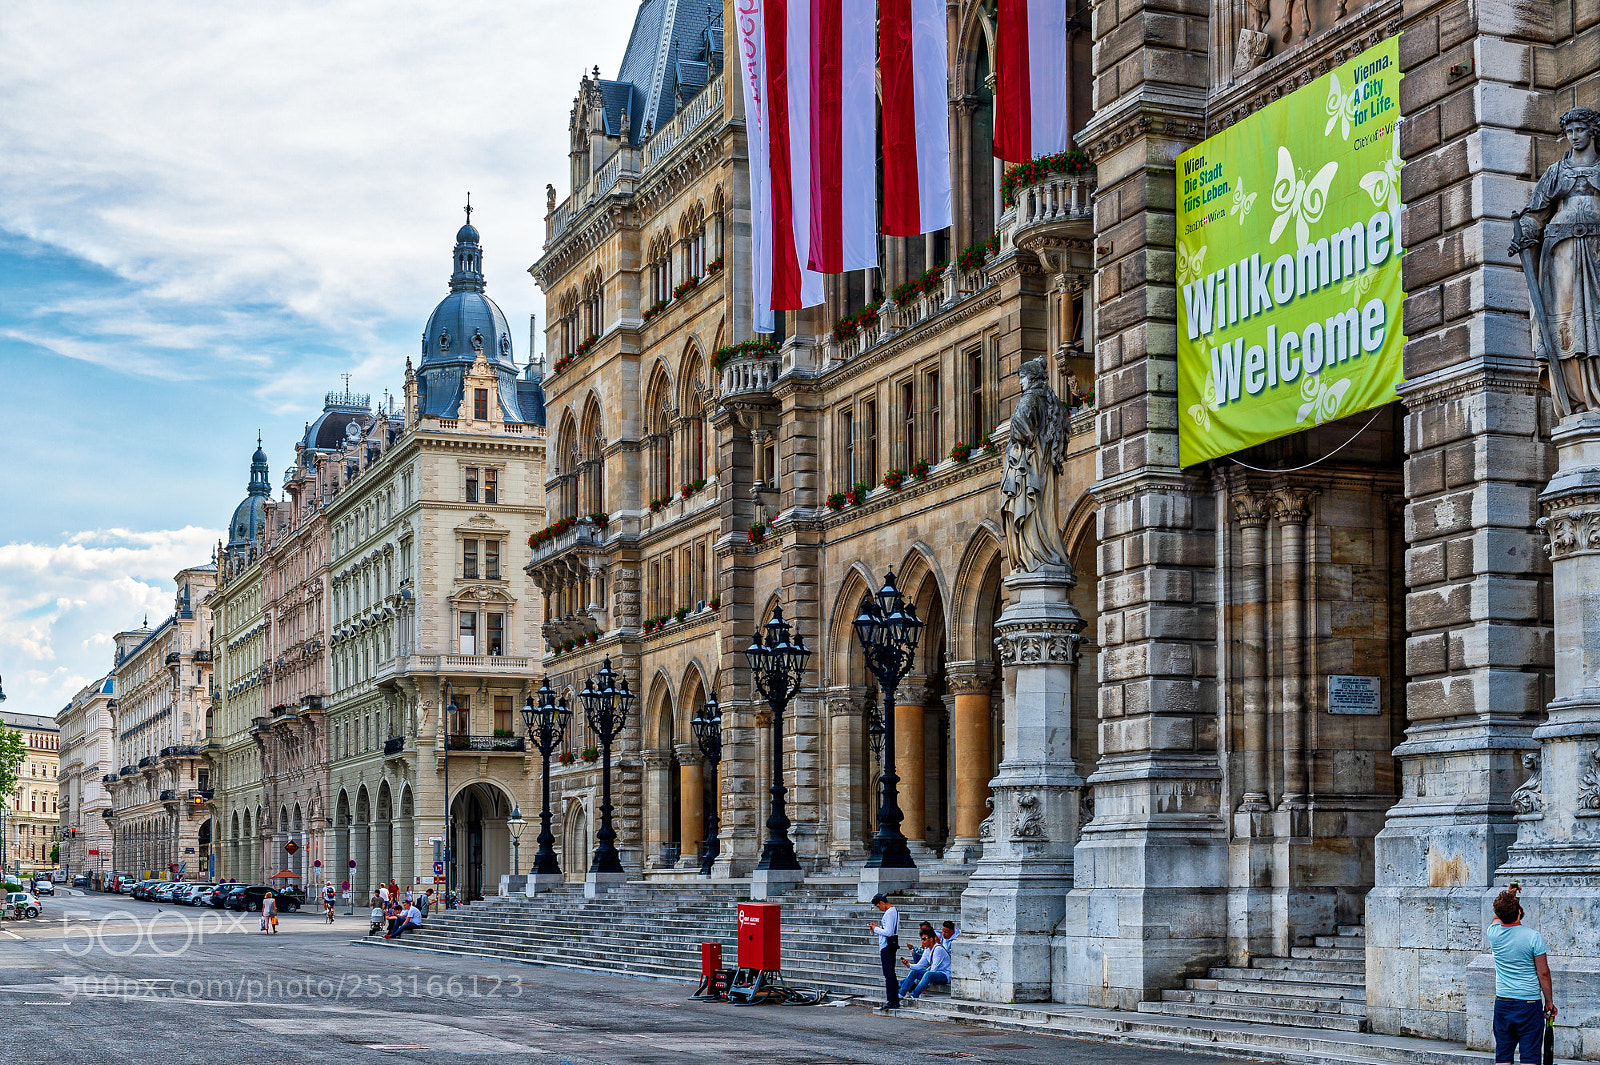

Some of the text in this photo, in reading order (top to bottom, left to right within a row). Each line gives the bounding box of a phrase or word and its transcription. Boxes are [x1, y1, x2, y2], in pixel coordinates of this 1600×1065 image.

[1354, 54, 1393, 85] Vienna.
[1353, 78, 1384, 107] A City
[1353, 95, 1395, 127] for Life.
[1184, 155, 1208, 176] Wien.
[1184, 162, 1223, 195] Die Stadt
[1184, 181, 1231, 214] fürs Leben.
[1207, 208, 1226, 223] Wien
[1211, 297, 1386, 406] Welcome
